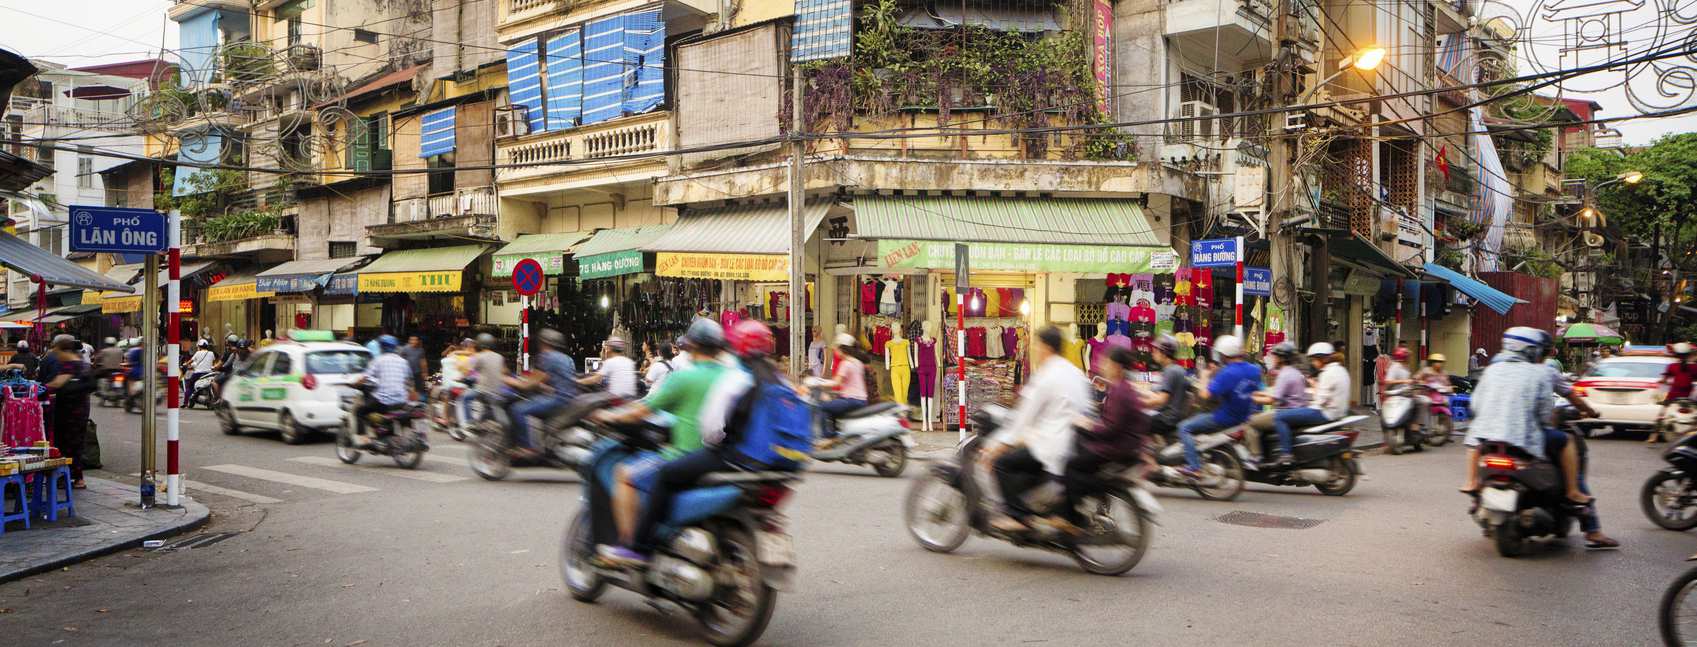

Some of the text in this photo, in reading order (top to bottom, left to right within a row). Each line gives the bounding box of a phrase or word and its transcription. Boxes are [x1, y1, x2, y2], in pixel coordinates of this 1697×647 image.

[113, 215, 140, 226] PHỐ
[80, 226, 157, 246] LÃN ÔNG
[1194, 250, 1235, 262] HÀNG ĐƯỜNG
[592, 260, 612, 273] HÀNG
